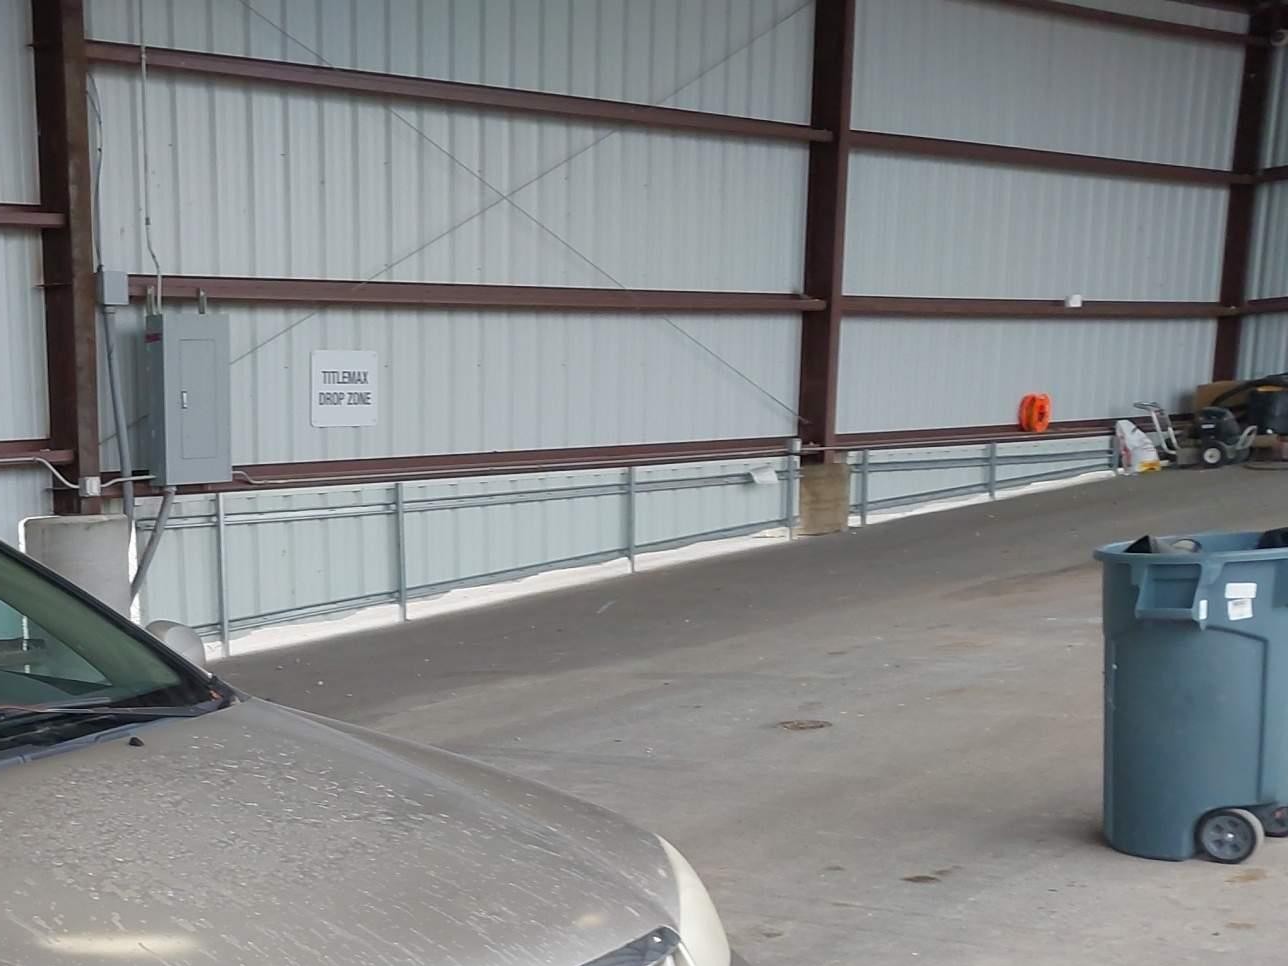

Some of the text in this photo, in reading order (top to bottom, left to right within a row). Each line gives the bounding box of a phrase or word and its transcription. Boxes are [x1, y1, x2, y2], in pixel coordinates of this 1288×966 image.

[320, 370, 369, 385] TITLEMAX
[318, 391, 372, 406] DROP ZONE
